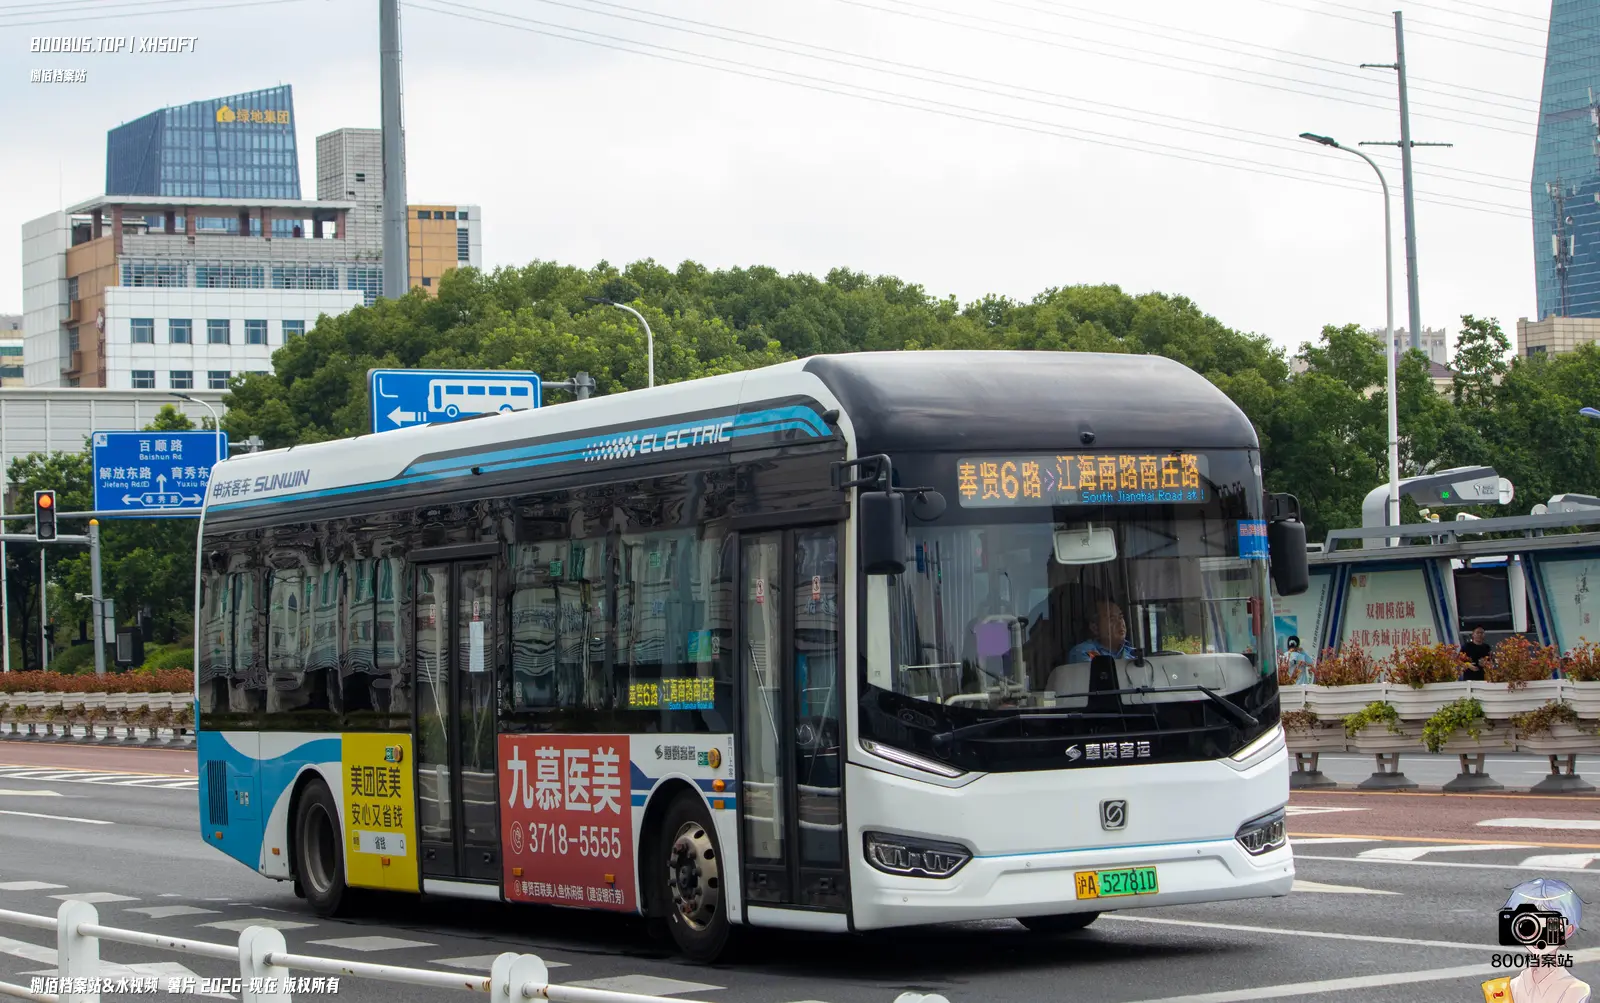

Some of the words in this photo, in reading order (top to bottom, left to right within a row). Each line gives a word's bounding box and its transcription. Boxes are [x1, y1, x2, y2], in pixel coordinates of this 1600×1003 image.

[236, 108, 290, 124] 绿地集团
[139, 439, 183, 452] 百顺路
[639, 421, 733, 454] ELECTRIC
[139, 453, 170, 461] Baishun
[99, 467, 152, 480] 解放东路
[171, 467, 210, 480] 育秀东
[253, 469, 310, 493] SUNWIN
[958, 460, 1042, 500] 奉贤6路
[1056, 453, 1200, 491] 江海南路南庄路
[102, 481, 128, 489] Jiefang
[212, 477, 252, 499] 申沃客车
[145, 496, 179, 504] 奉秀路
[1082, 490, 1114, 503] South
[1158, 489, 1183, 501] Road
[1186, 491, 1198, 500] at
[1366, 601, 1415, 619] 双拥模范城
[1350, 628, 1432, 647] 是优秀城市的标配
[1085, 741, 1151, 760] 奉贤客运
[351, 765, 401, 798] 美团医美
[507, 745, 622, 815] 九慕医美
[351, 802, 403, 828] 安心又省钱
[528, 822, 622, 859] 3718-5555
[1077, 876, 1097, 895] 沪A
[1102, 870, 1157, 894] 52781D
